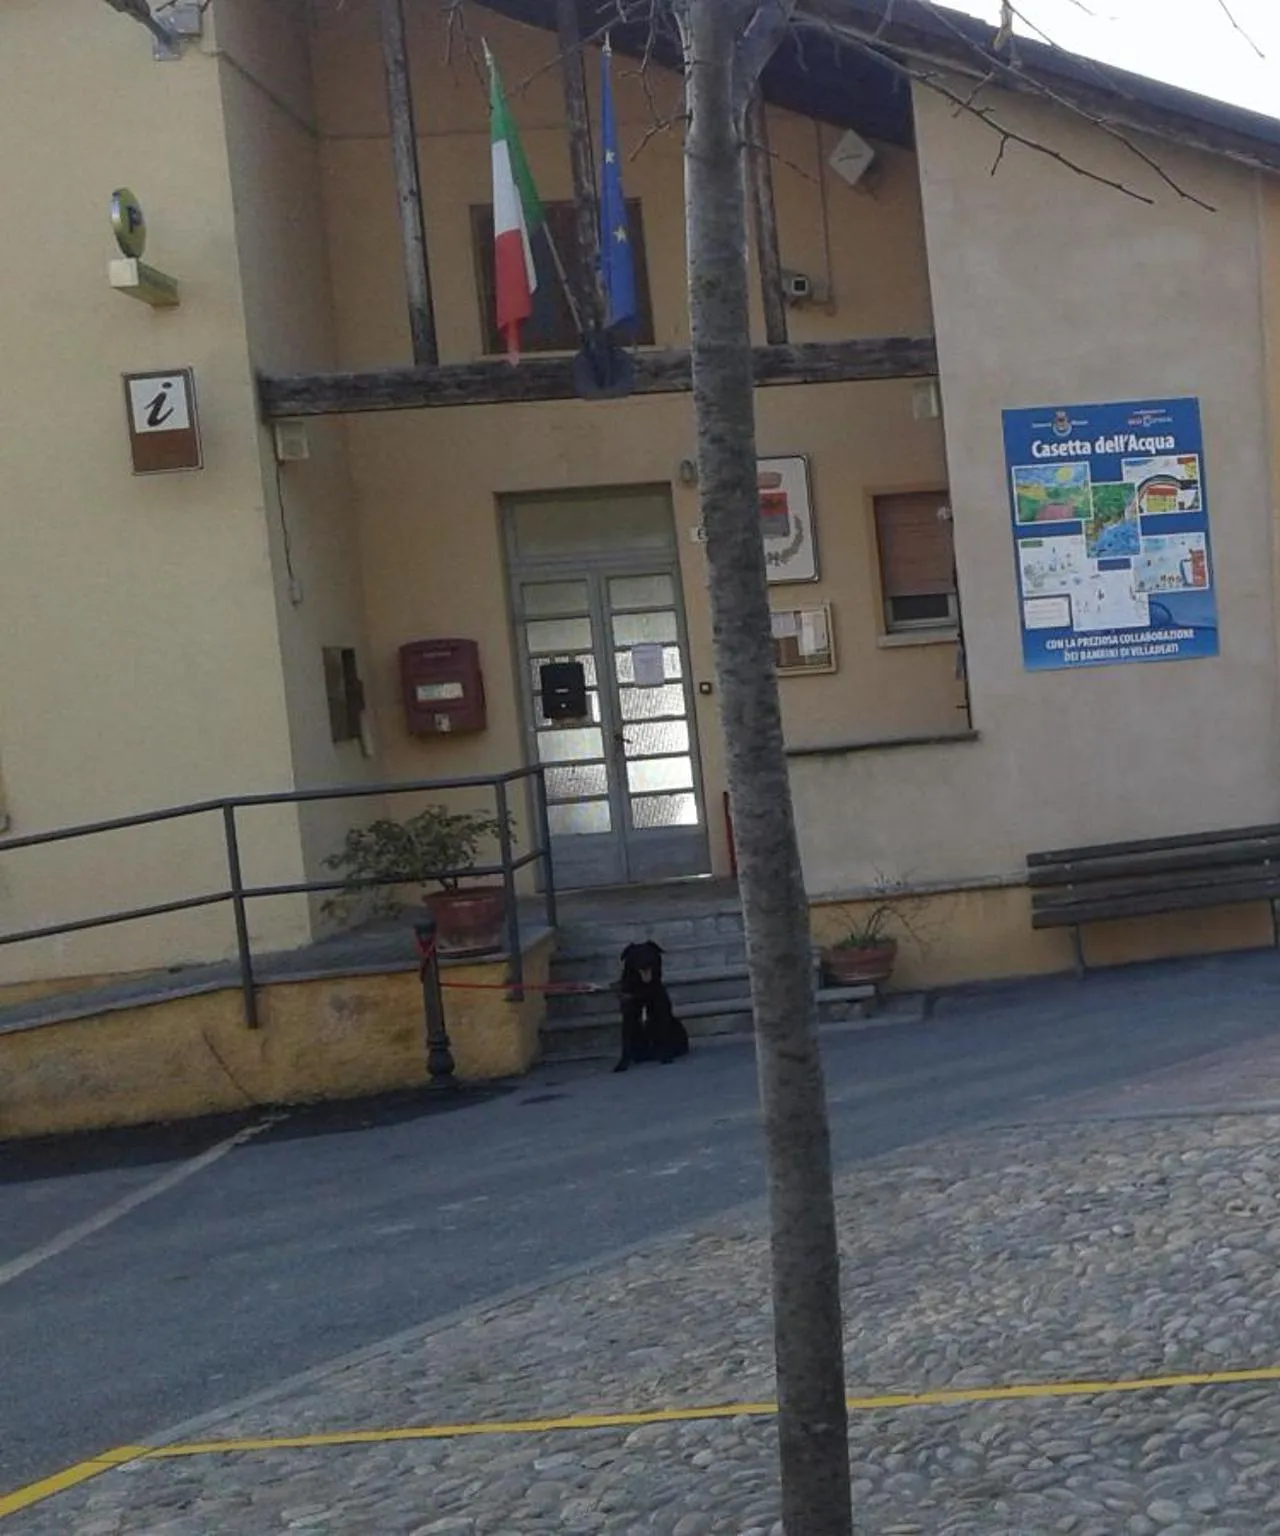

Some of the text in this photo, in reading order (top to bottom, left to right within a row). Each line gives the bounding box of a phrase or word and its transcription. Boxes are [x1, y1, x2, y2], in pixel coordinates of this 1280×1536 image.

[1031, 433, 1175, 458] Casetta dell'Acqua
[1045, 628, 1195, 650] CON LA PREZIOSA COLLABORAZIONE
[1064, 650, 1079, 662] DEI
[1080, 648, 1119, 661] BAMBINI
[1120, 647, 1130, 658] DI
